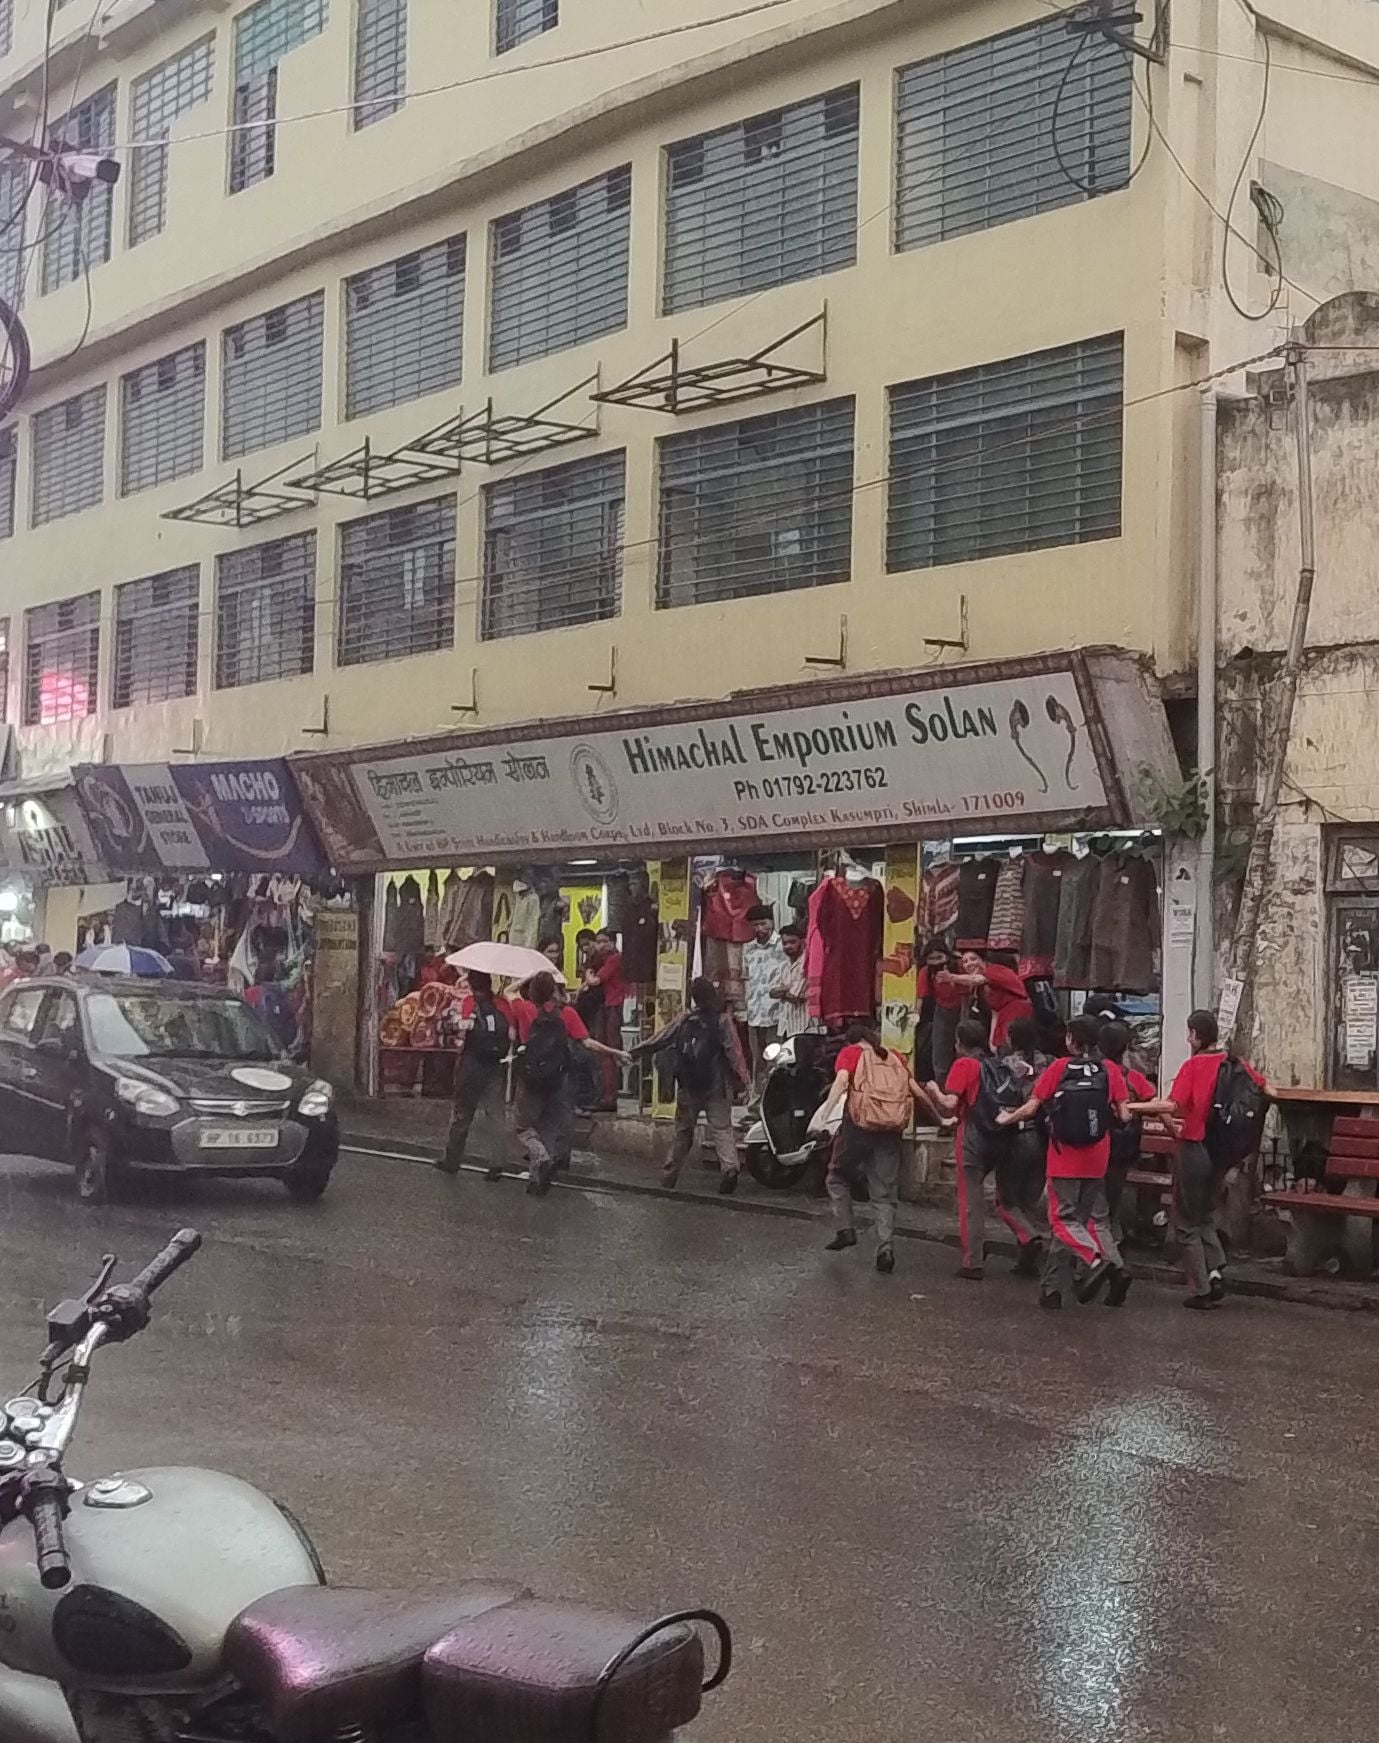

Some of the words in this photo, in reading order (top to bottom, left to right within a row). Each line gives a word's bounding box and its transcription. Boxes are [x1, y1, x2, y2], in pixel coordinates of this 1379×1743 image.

[622, 722, 748, 775] Himachal
[750, 710, 898, 768] Emporium
[904, 696, 998, 745] Solan
[209, 771, 280, 801] MACHO
[733, 780, 760, 801] Ph
[762, 766, 889, 799] 01792-223762
[657, 821, 693, 836] Block
[737, 814, 769, 830] SDA
[961, 790, 1026, 812] 171009
